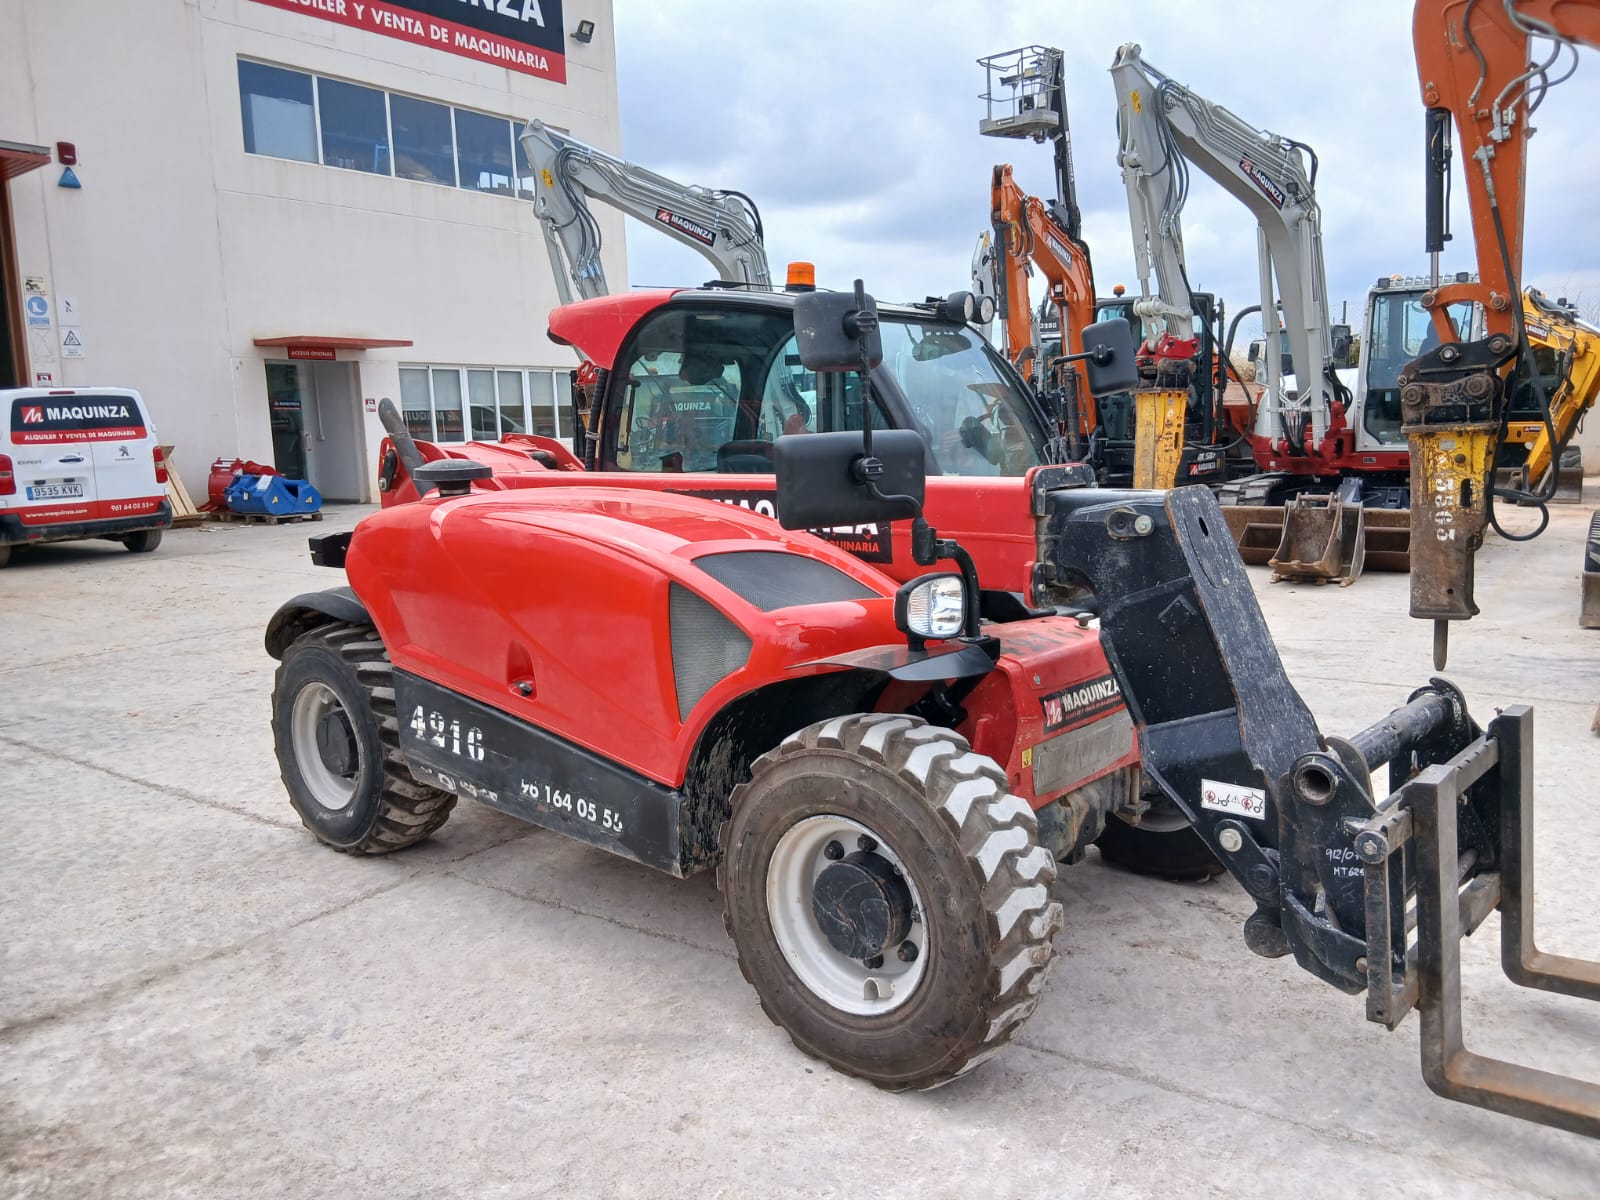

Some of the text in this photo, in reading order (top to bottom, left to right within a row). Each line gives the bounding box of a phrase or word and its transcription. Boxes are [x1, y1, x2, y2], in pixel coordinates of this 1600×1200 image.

[353, 3, 365, 20] Y
[371, 8, 425, 38] VENTA
[430, 24, 449, 43] DE
[455, 31, 549, 72] MAQUINARIA
[1252, 166, 1283, 203] MAQUINZA
[671, 214, 713, 241] MAQUINZA
[46, 405, 130, 421] MAQUINZA
[97, 430, 137, 438] MAQUINARIA
[34, 485, 80, 497] 9535 KVK
[123, 503, 132, 511] 64
[1062, 678, 1120, 712] MAQUINZA
[410, 705, 485, 762] 4216
[544, 785, 572, 812] 164
[576, 798, 597, 822] 05
